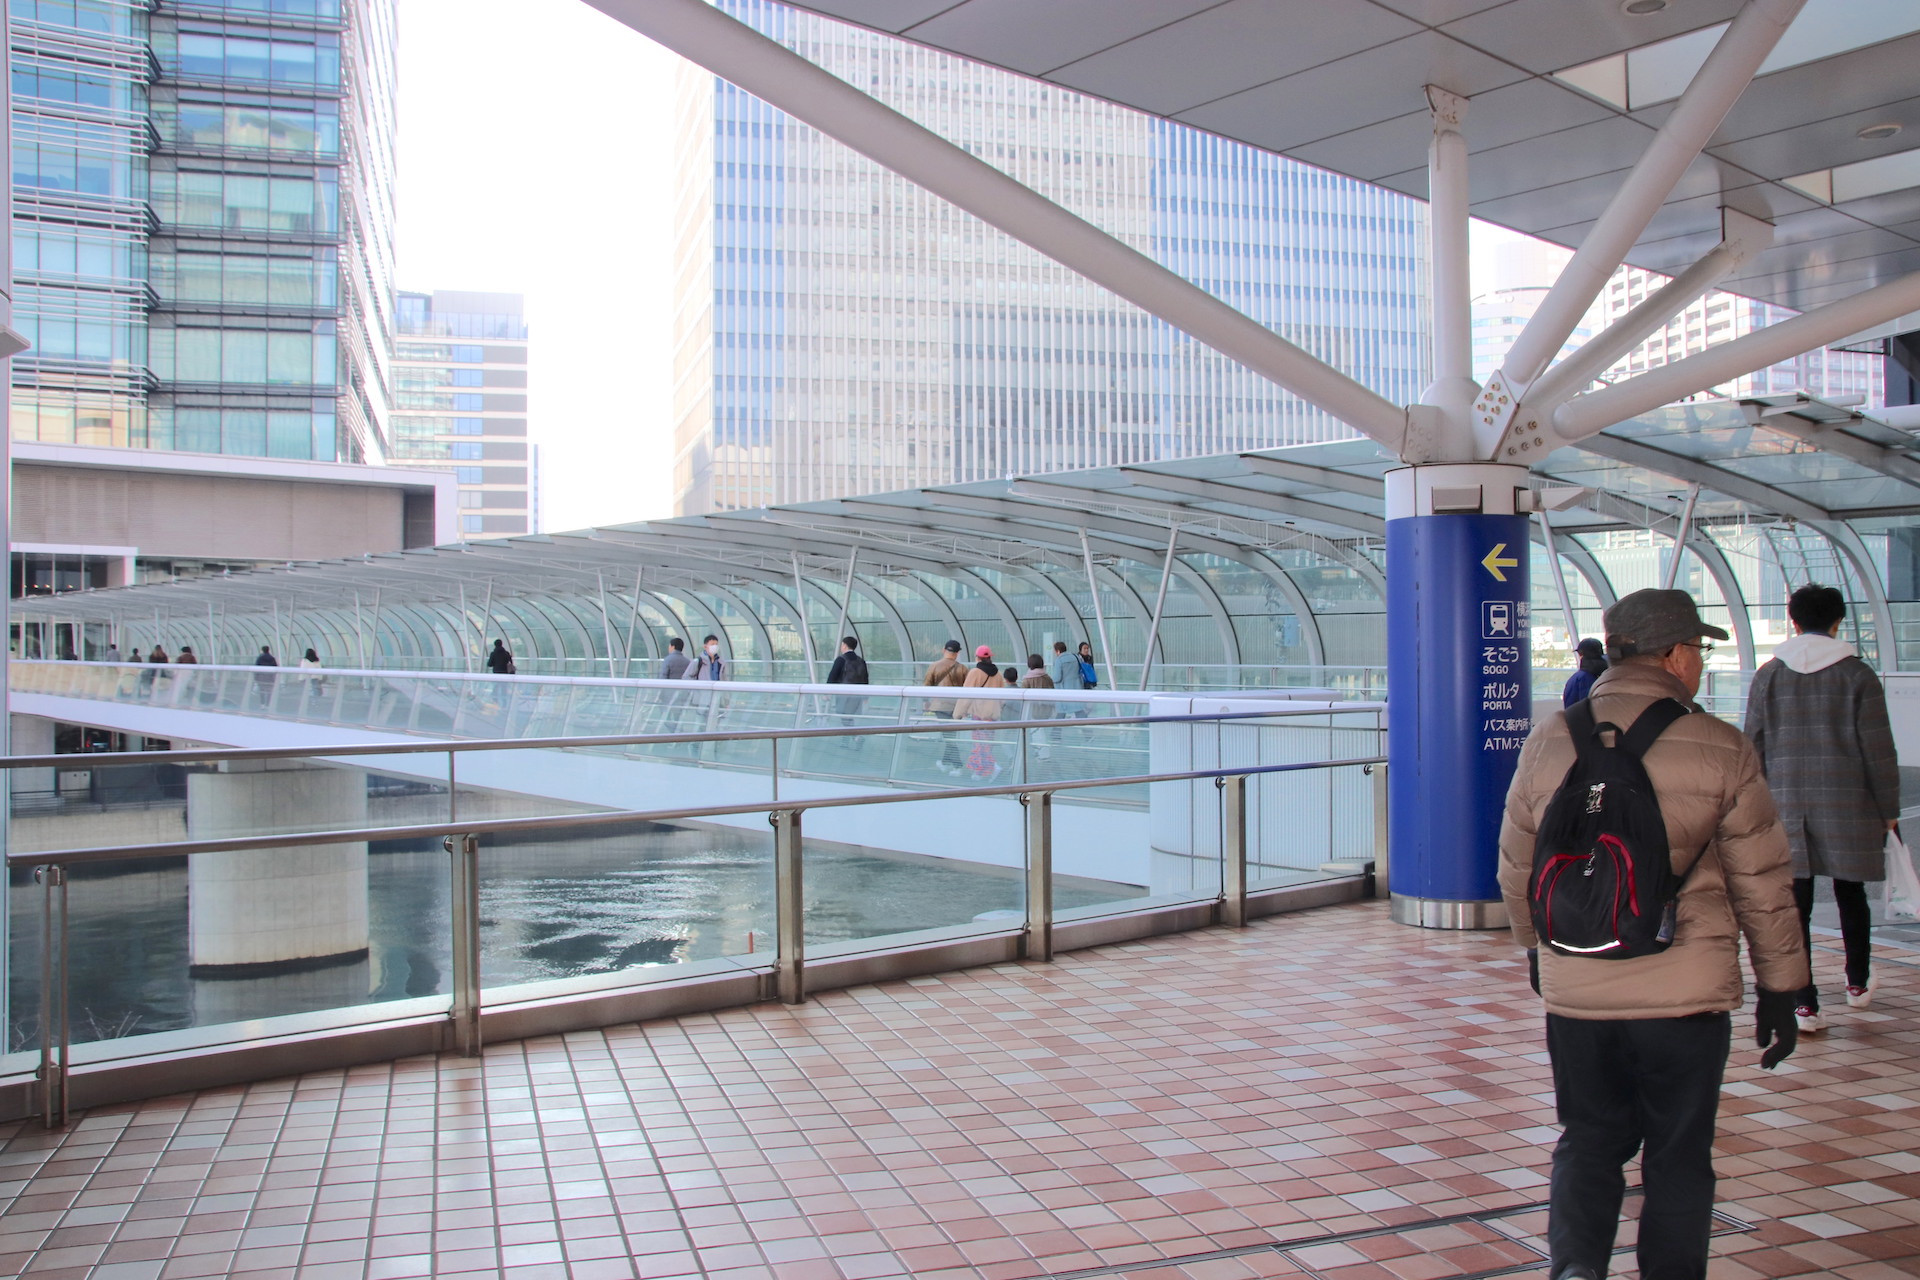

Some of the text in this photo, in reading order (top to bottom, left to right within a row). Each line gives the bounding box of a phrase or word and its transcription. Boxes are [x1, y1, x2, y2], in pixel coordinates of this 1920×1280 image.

[1482, 646, 1519, 663] そごう
[1482, 665, 1509, 675] SOGO
[1483, 682, 1520, 699] ポルタ
[1483, 701, 1512, 710] PORTA
